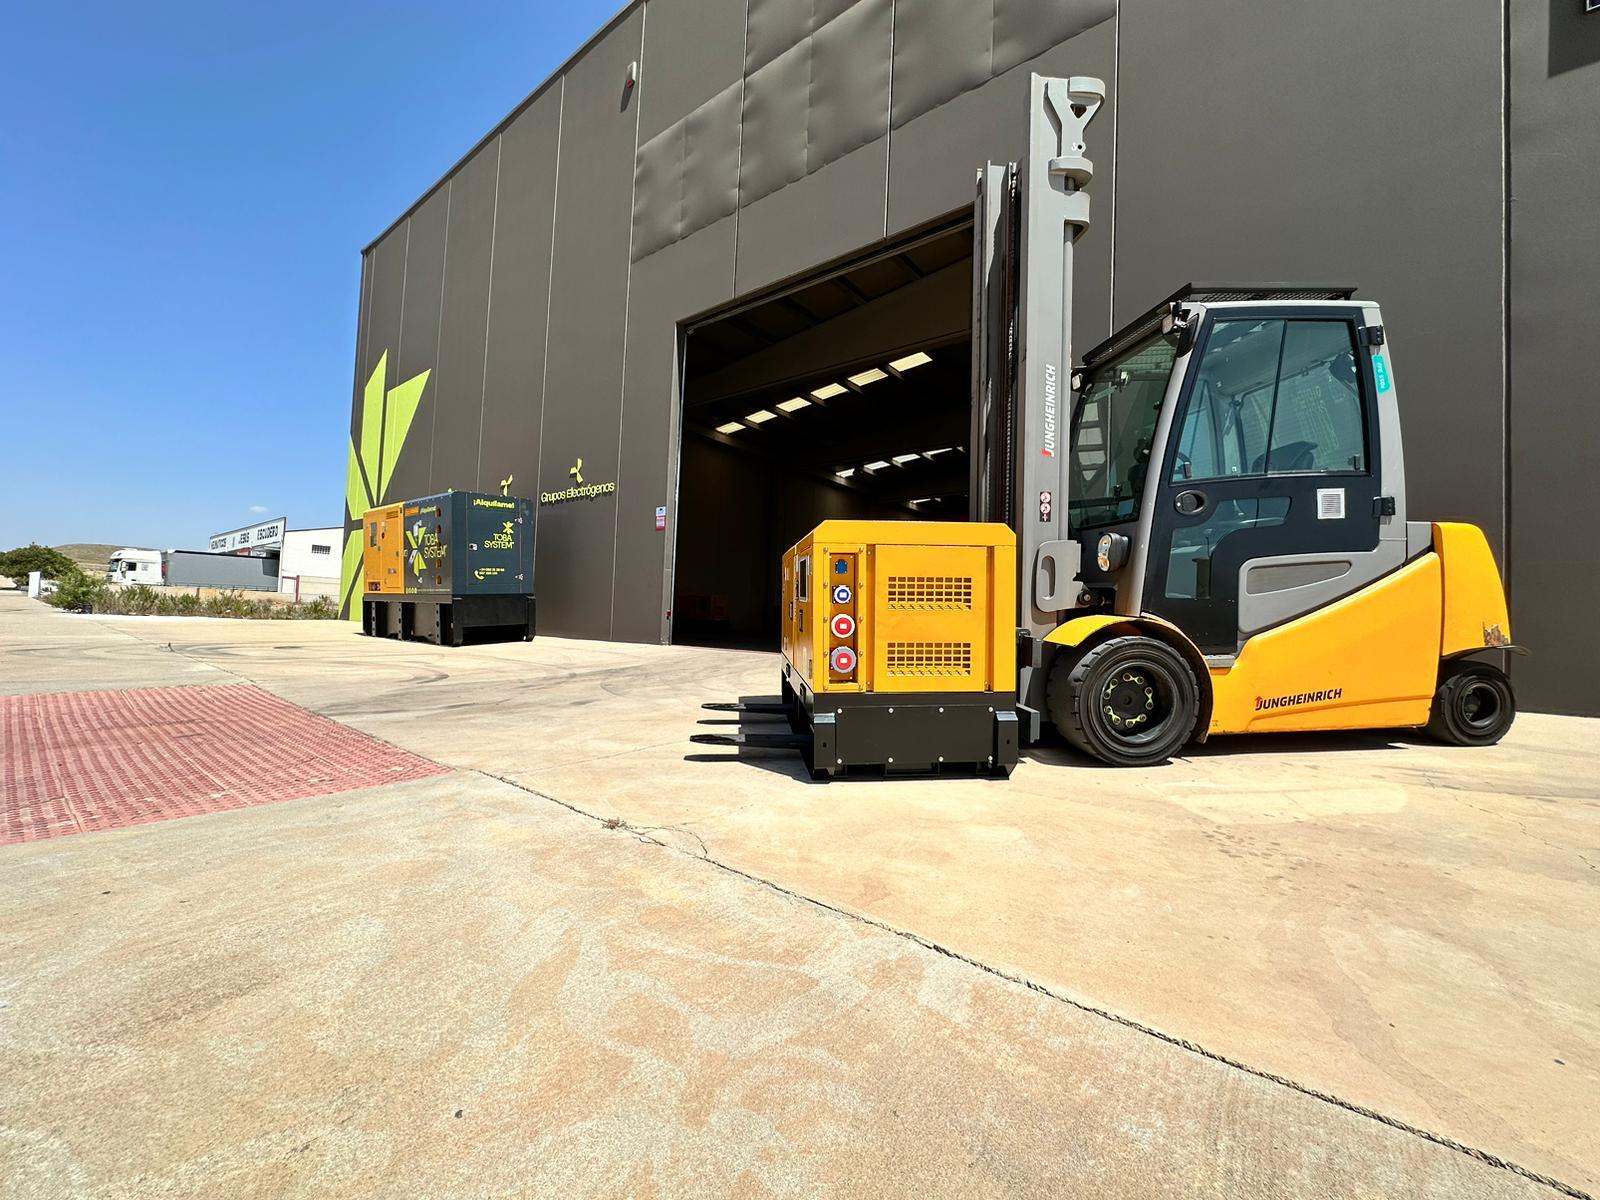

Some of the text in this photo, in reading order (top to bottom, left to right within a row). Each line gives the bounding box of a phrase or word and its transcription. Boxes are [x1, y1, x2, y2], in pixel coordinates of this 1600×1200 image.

[1041, 364, 1056, 457] JUNGHEINRICH
[541, 482, 615, 503] Grupos Electrógenos
[493, 533, 512, 542] TOBA
[1255, 688, 1343, 711] JUNGHEINRICH
